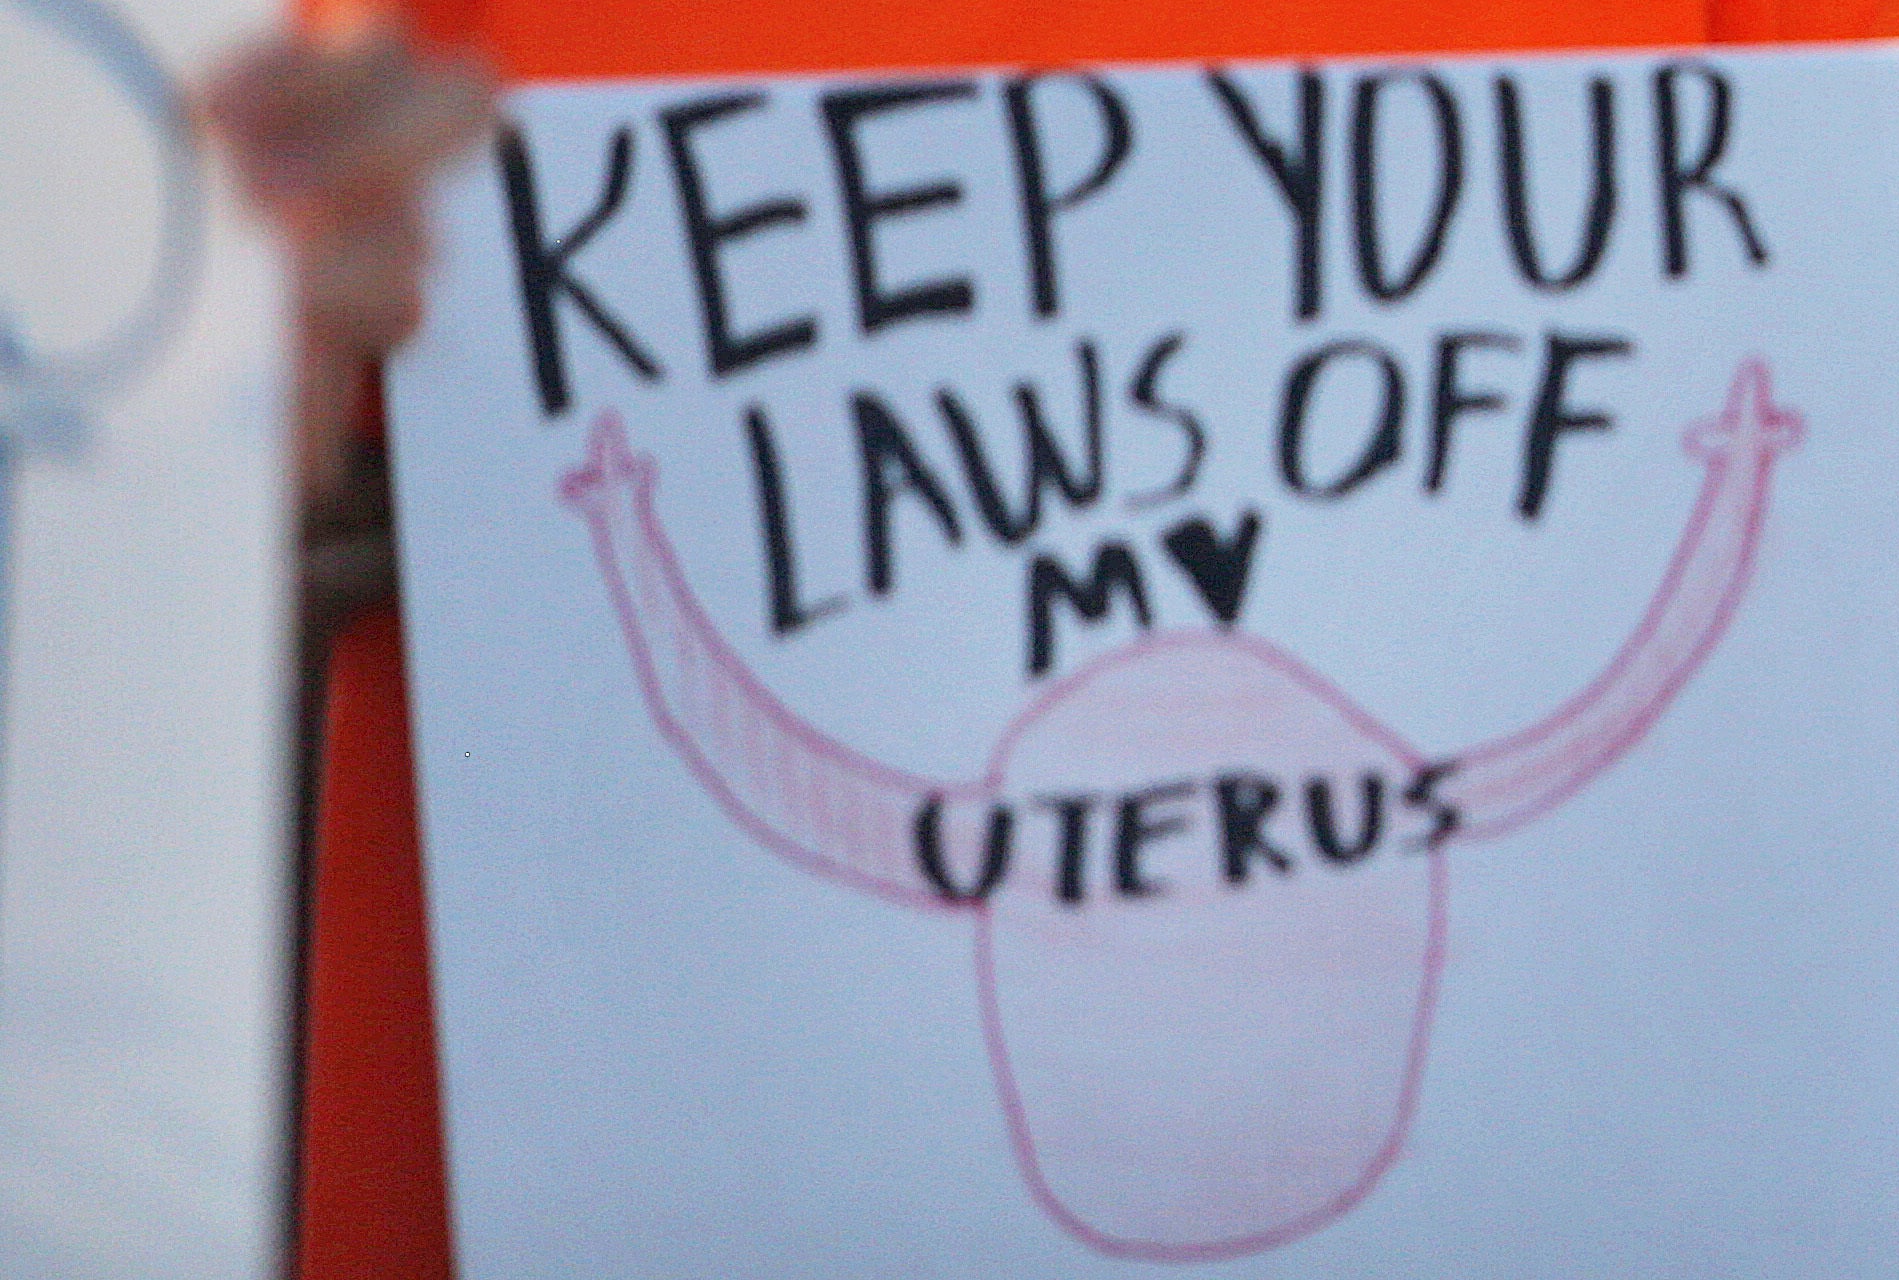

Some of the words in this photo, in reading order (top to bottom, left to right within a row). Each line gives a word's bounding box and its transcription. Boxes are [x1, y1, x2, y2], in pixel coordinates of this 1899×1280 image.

[500, 72, 1136, 420] KEEP
[1205, 61, 1770, 322] YOUR
[742, 332, 1205, 638] LAWS
[1277, 332, 1632, 522] OFF
[911, 758, 1468, 908] UTERUS
